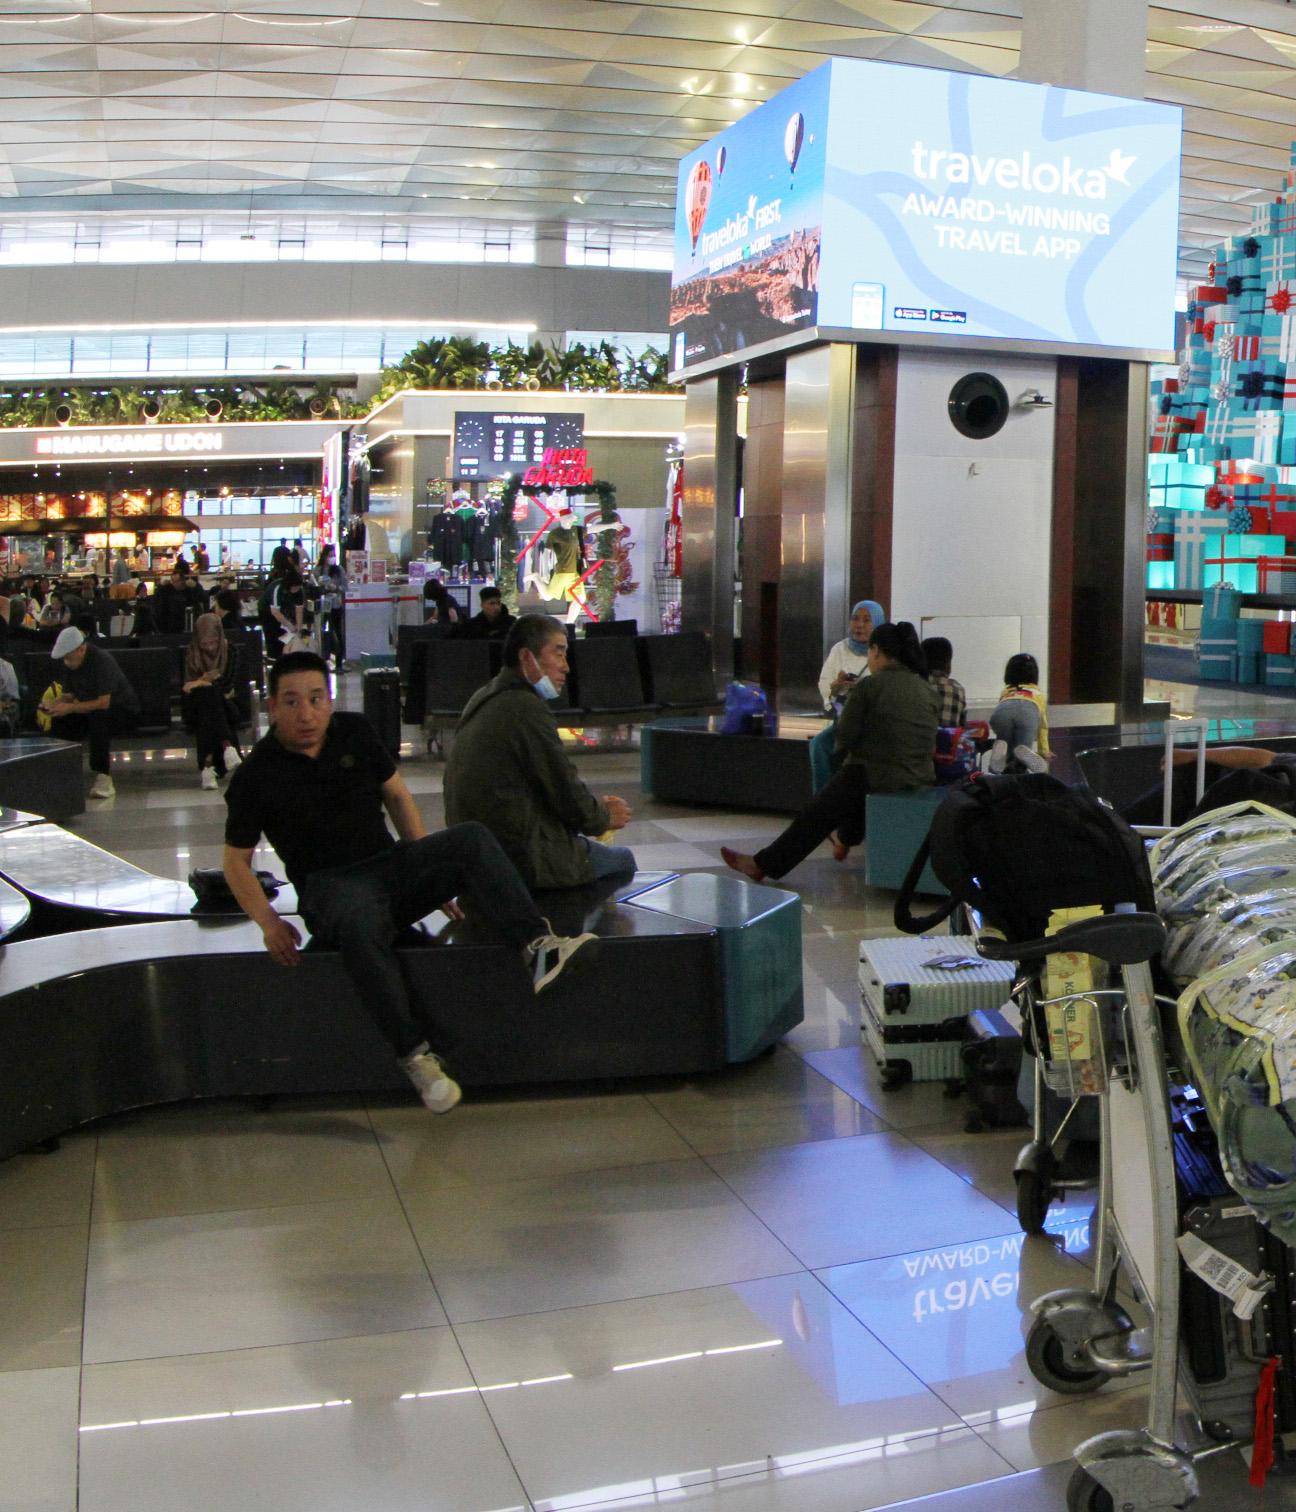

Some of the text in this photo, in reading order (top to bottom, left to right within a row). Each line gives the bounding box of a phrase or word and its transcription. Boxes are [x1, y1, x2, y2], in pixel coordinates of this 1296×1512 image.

[911, 140, 1107, 200] traveloka
[702, 212, 749, 256] traveloka
[755, 198, 782, 231] FIRST,
[902, 192, 1111, 236] AWARD-WINNING
[934, 225, 1081, 260] TRAVEL APP
[493, 415, 546, 425] KITA GARUDA
[51, 432, 222, 454] MARUGAME UDON
[523, 467, 594, 486] GARUDA
[1064, 981, 1077, 1023] KÖNER
